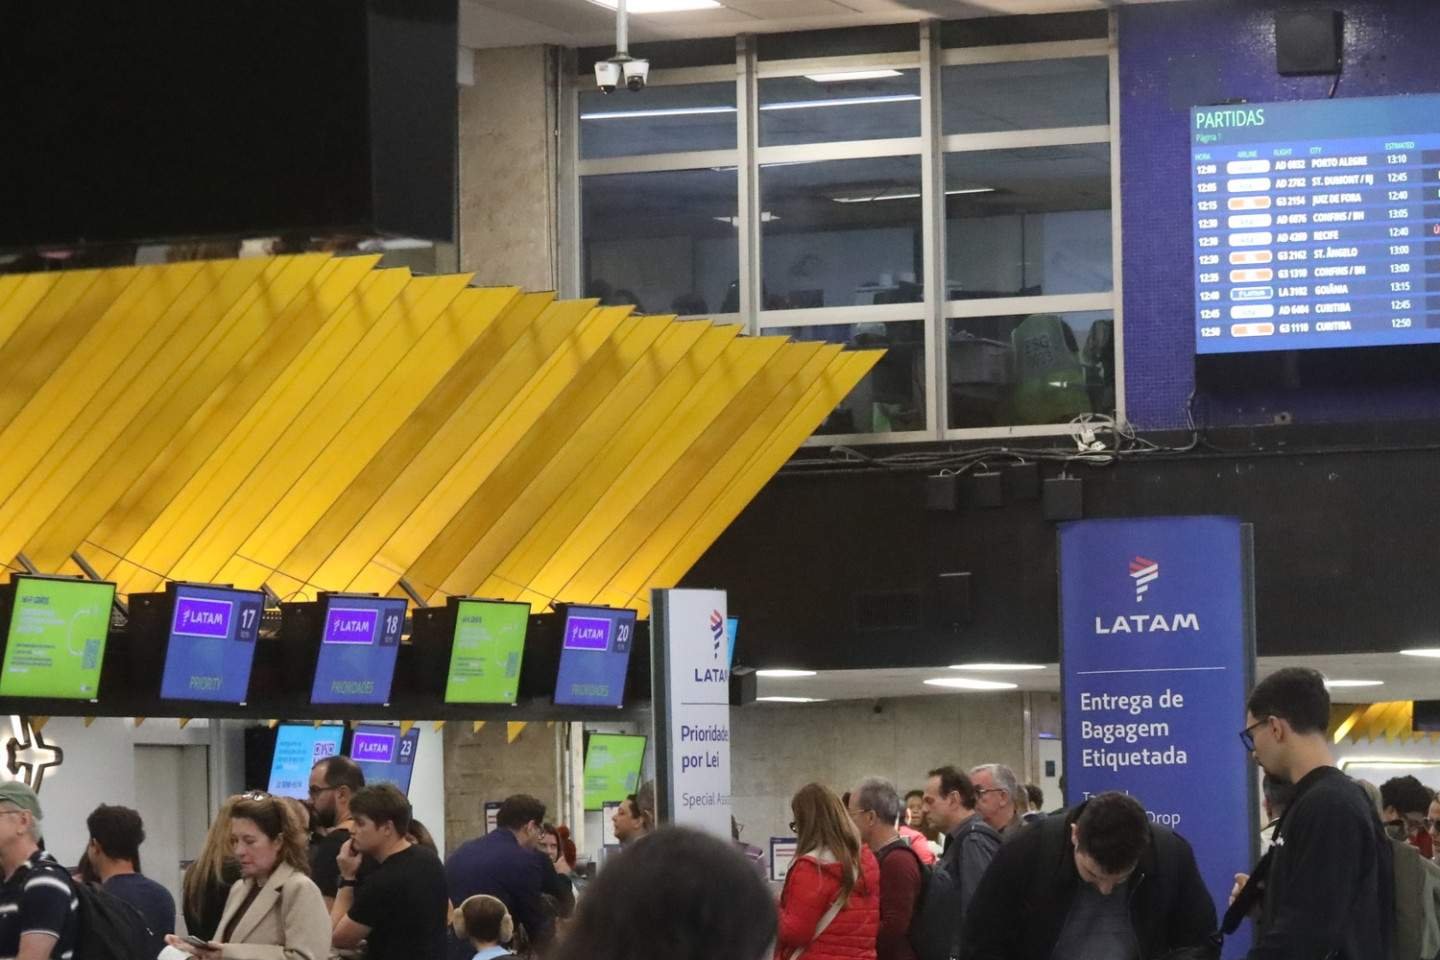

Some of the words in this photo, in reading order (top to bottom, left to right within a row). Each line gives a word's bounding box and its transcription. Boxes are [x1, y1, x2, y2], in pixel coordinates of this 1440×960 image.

[1196, 109, 1264, 129] PARTIDAS
[1312, 158, 1338, 167] PORTO
[1338, 157, 1367, 166] ALEGRE
[1388, 155, 1407, 163] 13:10
[1388, 173, 1407, 182] 12:45
[1389, 191, 1408, 200] 12:40
[1389, 209, 1408, 218] 13:05
[1314, 231, 1338, 240] RECIFE
[1390, 228, 1408, 236] 12:40
[1390, 246, 1409, 254] 13:00
[1391, 264, 1409, 272] 13:00
[1315, 284, 1348, 294] GOIÂNIA
[1391, 282, 1410, 291] 13:15
[1315, 303, 1351, 312] CURITIBA
[1392, 300, 1410, 309] 12:45
[1316, 321, 1351, 331] CURITIBA
[1392, 318, 1411, 327] 12:50
[191, 612, 223, 625] LATAM
[241, 609, 256, 629] 17
[338, 620, 369, 633] LATAM
[385, 615, 398, 635] 18
[1095, 613, 1200, 634] LATAM
[578, 627, 604, 639] LATAM
[616, 624, 629, 642] 20
[189, 675, 224, 690] PRIORITY
[1081, 692, 1152, 715] Entrega
[1159, 688, 1184, 708] de
[1082, 721, 1169, 744] Bagagem
[362, 741, 388, 753] LATAM
[400, 739, 412, 755] 23
[682, 754, 703, 773] por
[706, 751, 720, 768] Lei
[1082, 745, 1188, 772] Etiquetada
[682, 791, 715, 809] Special
